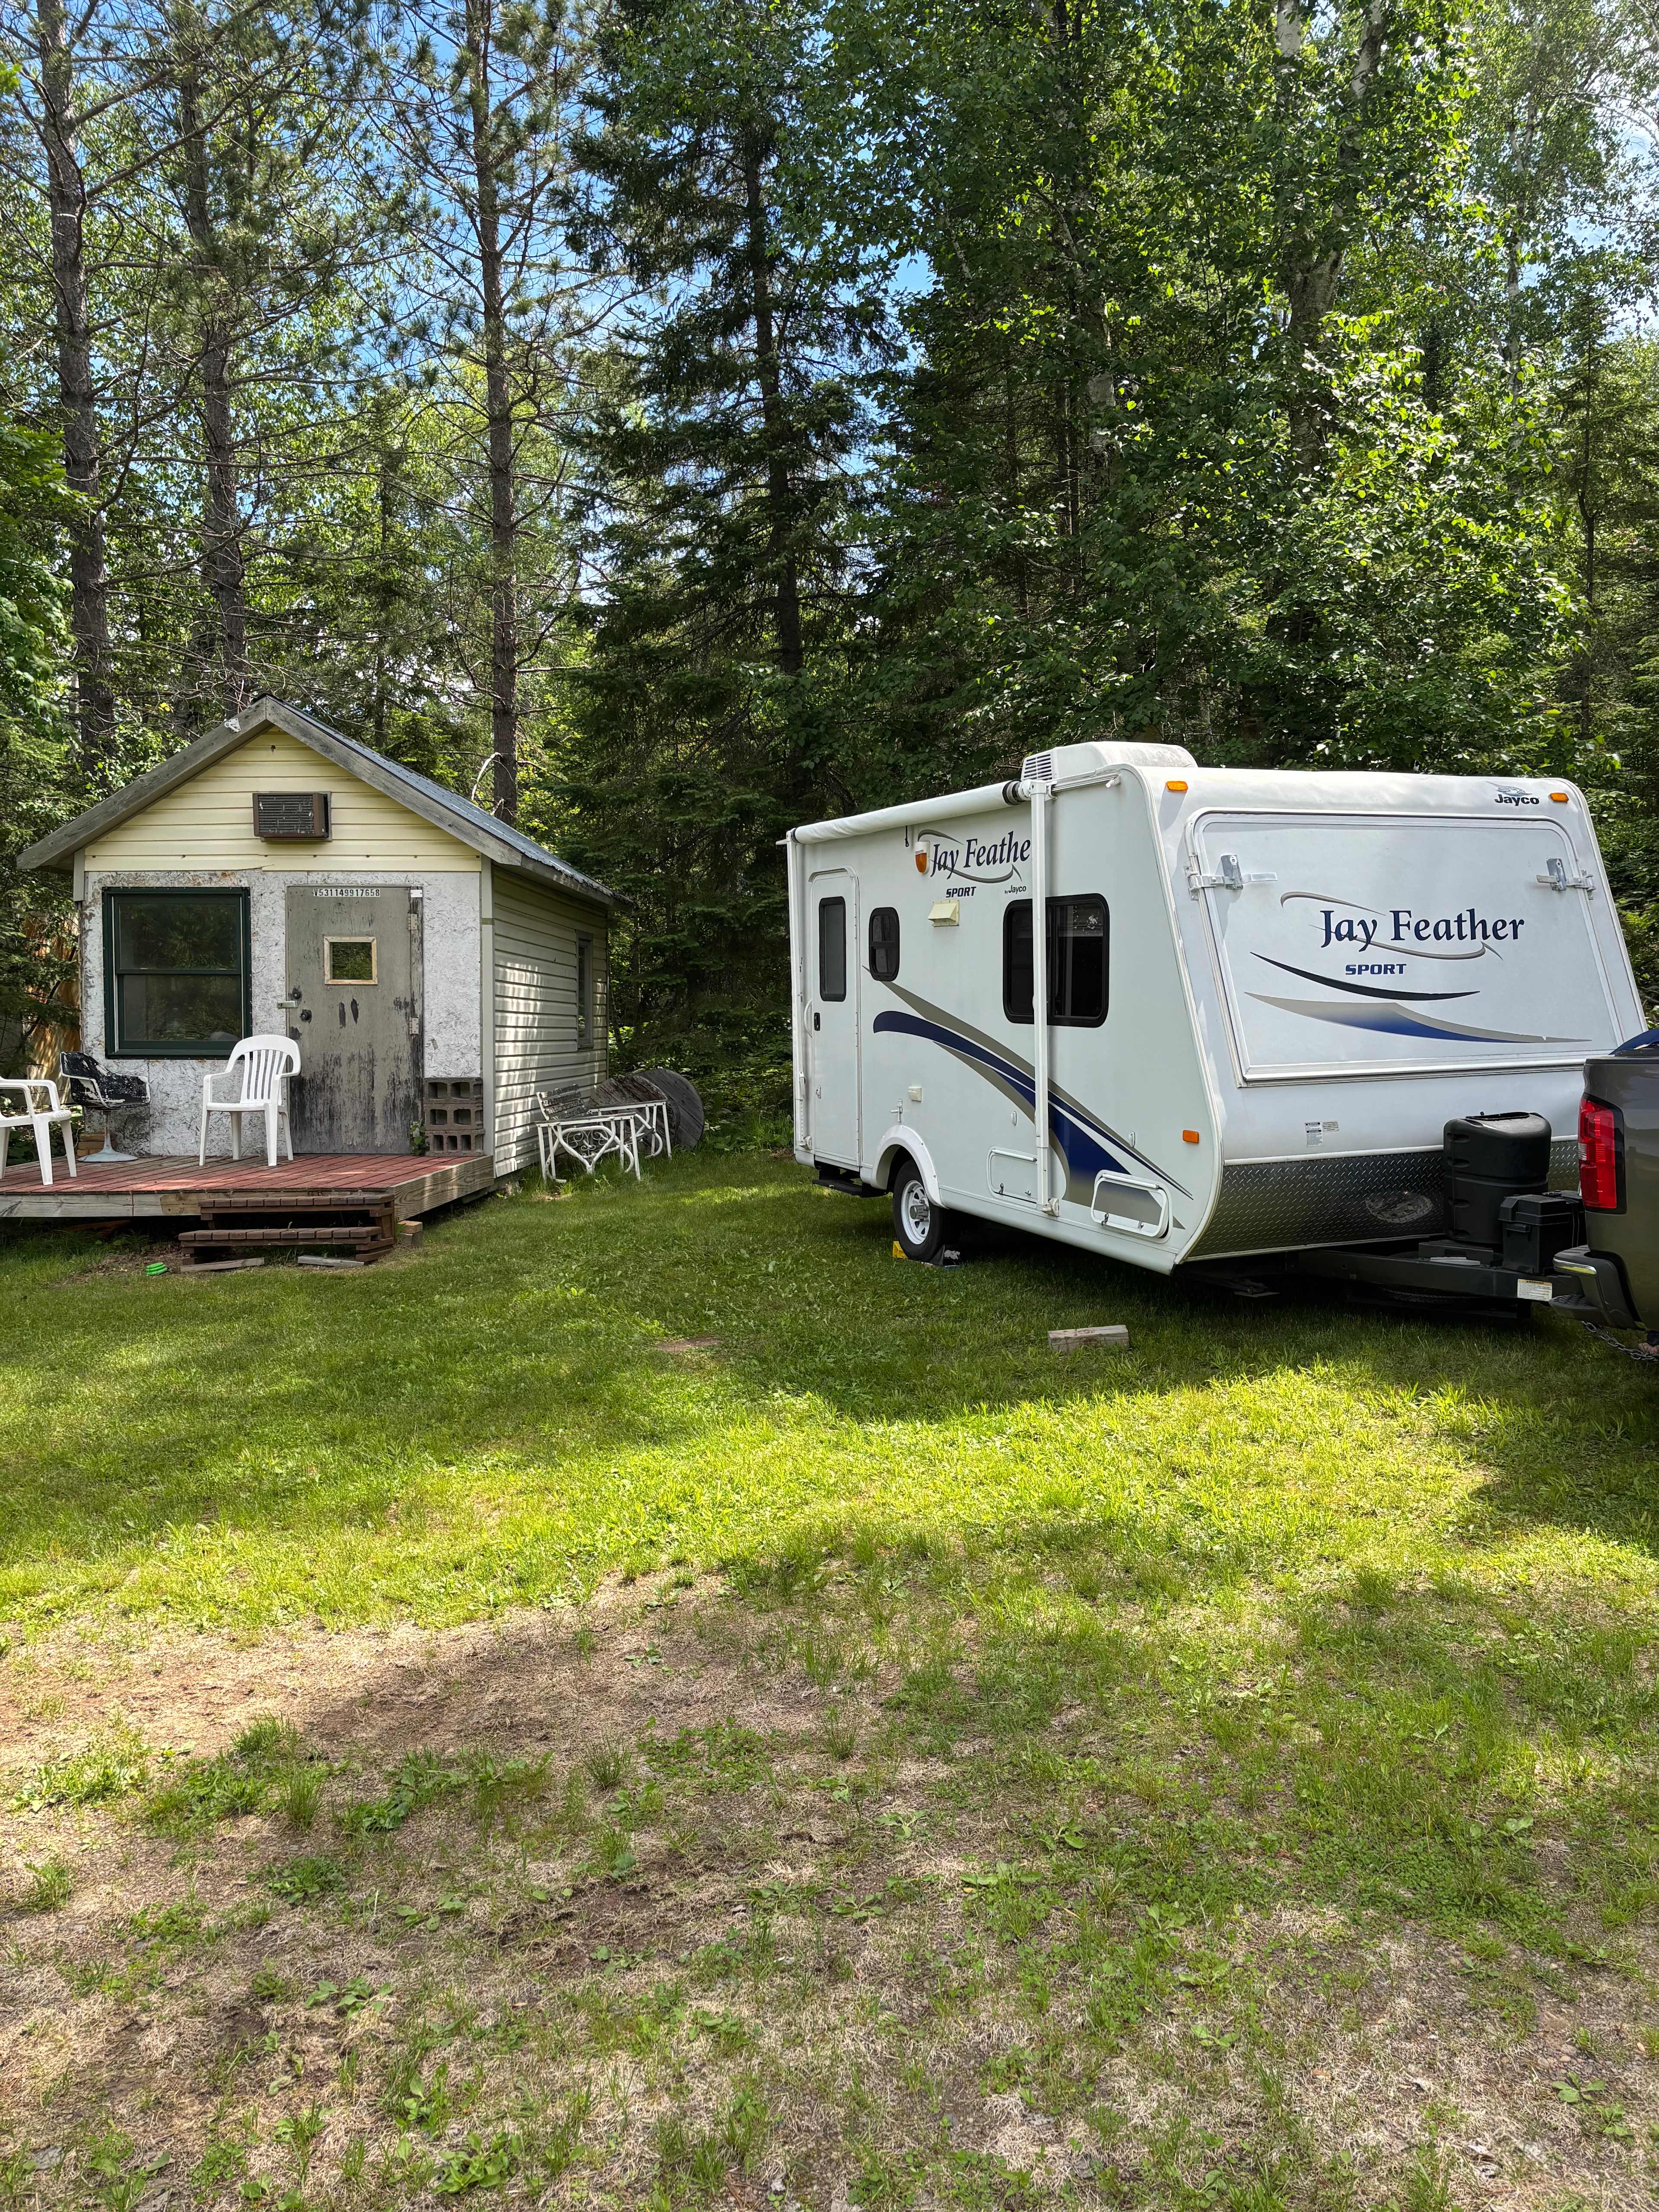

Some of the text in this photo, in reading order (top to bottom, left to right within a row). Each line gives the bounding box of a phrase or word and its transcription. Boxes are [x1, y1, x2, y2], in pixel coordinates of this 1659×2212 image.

[1494, 794, 1540, 806] Jayco
[930, 831, 1031, 880] Jay Feathe
[946, 887, 976, 898] SPORT
[1008, 885, 1027, 894] Jayco
[1320, 908, 1525, 952] Jay Feather
[1345, 964, 1407, 975] SPORT
